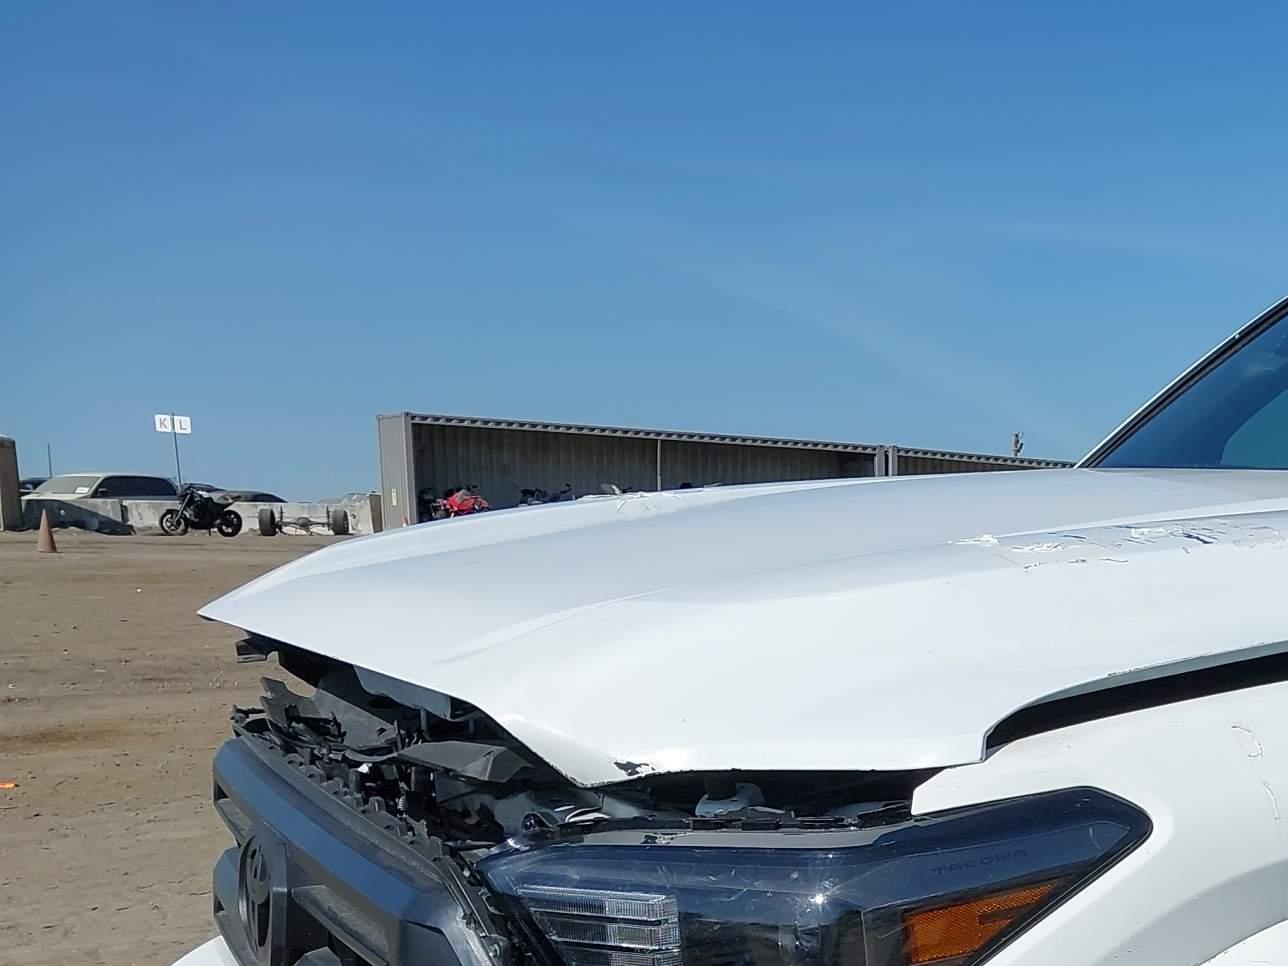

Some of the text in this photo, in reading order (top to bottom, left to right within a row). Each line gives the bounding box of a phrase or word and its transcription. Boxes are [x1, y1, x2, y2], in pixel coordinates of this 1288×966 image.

[158, 417, 168, 429] K
[179, 418, 188, 431] L
[931, 849, 1028, 874] TACOMA
